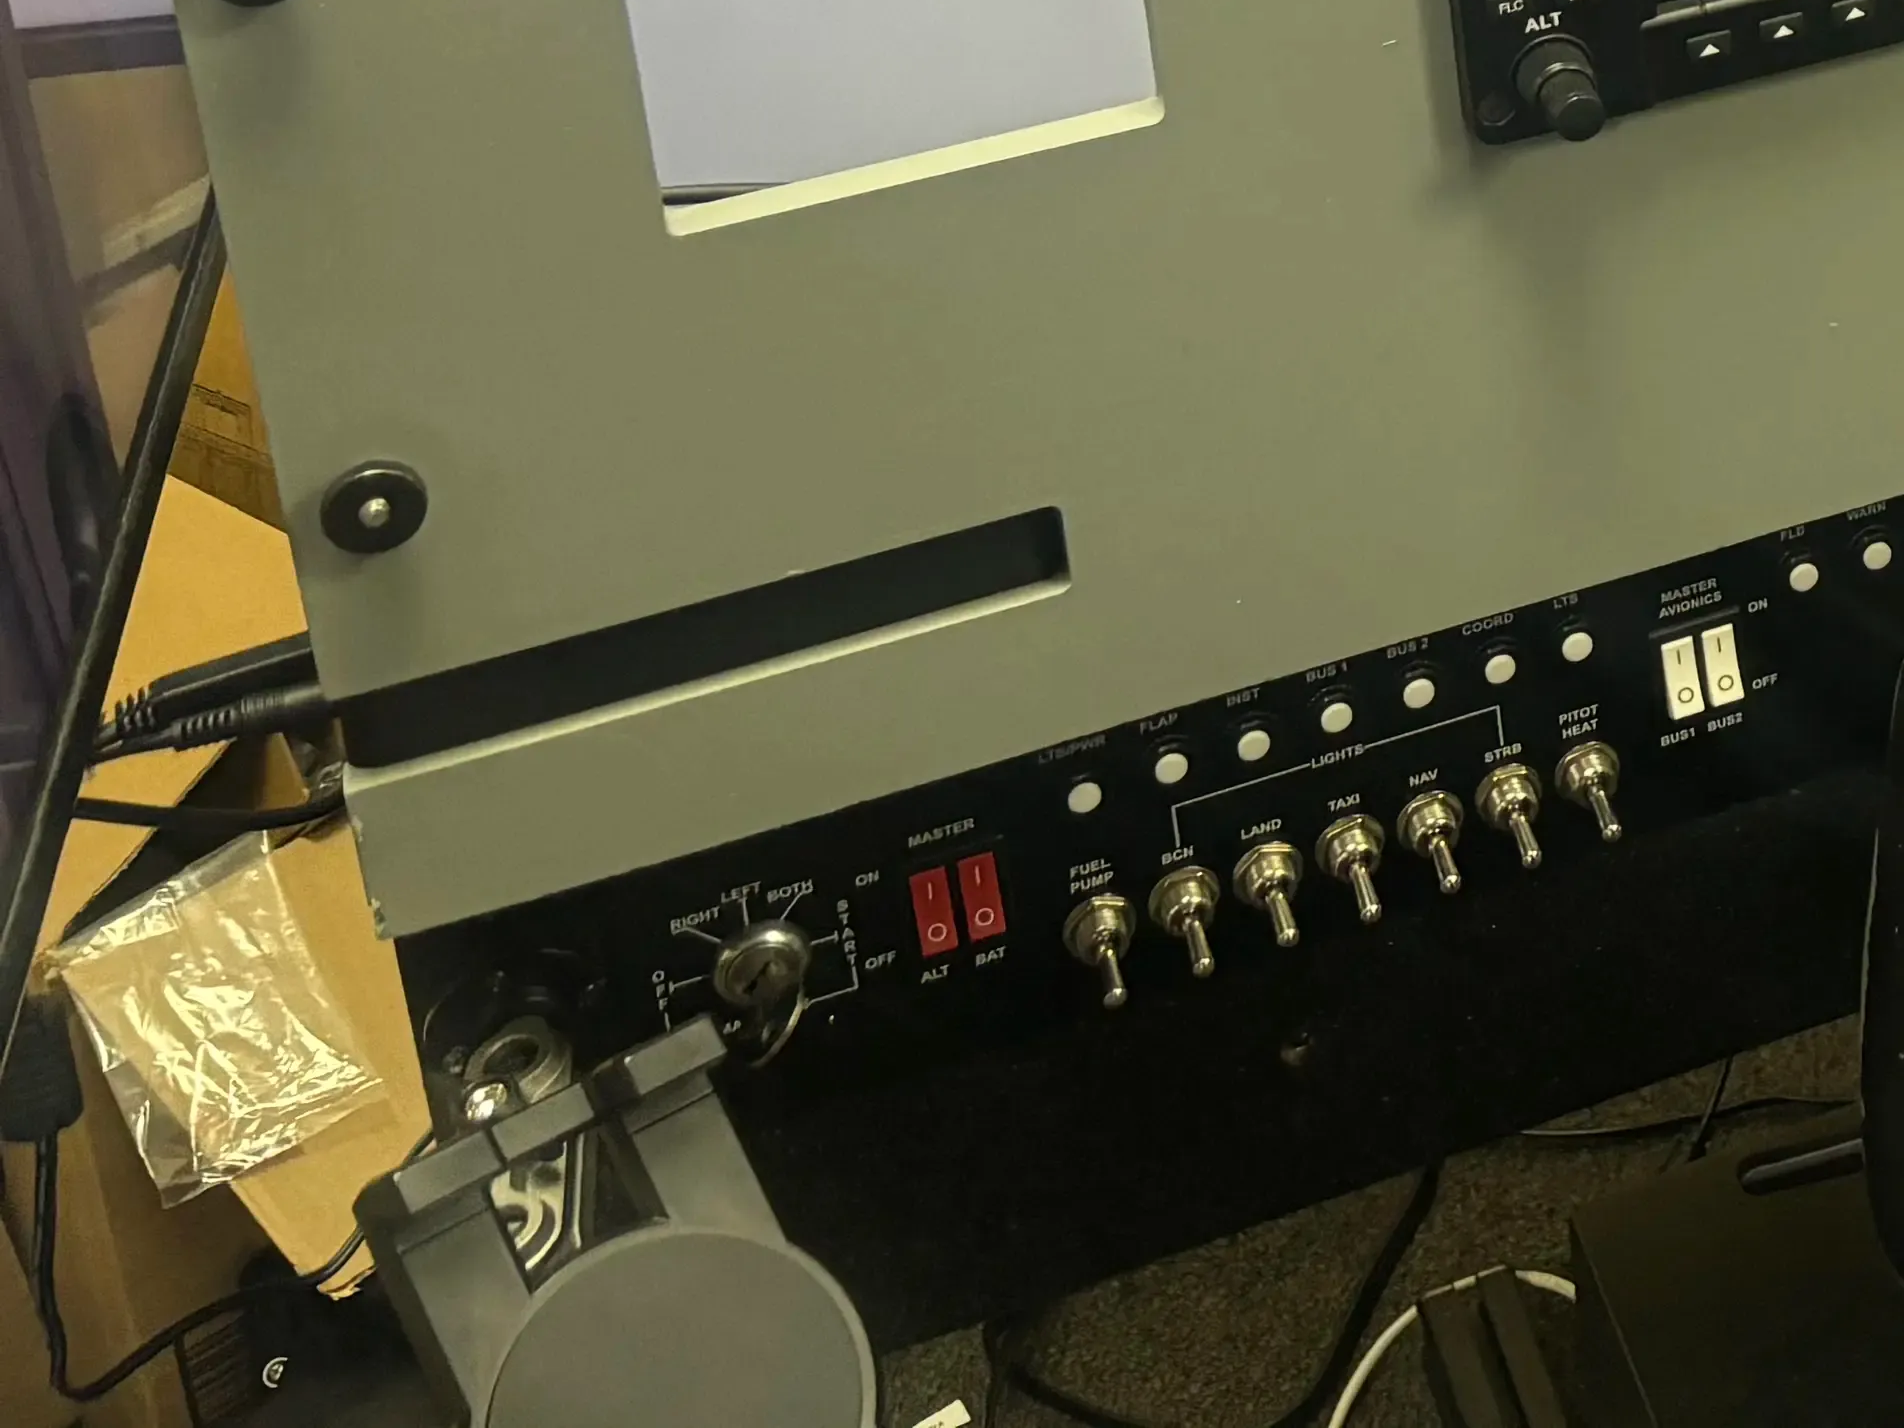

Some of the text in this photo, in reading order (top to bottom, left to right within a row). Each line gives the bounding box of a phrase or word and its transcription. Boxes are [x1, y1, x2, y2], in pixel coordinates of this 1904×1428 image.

[1661, 577, 1717, 604] MASTER
[1659, 591, 1722, 619] AVIONICS
[1752, 673, 1778, 690] OFF
[1558, 704, 1598, 727] PITOT
[1562, 718, 1598, 739] HEAT
[1660, 727, 1696, 748] BUS1
[1311, 743, 1365, 769] LIGHTS
[1484, 743, 1522, 763] STRB
[1409, 768, 1438, 788] NAV
[1328, 793, 1360, 813] TAXI
[908, 818, 974, 848] MASTER
[1241, 818, 1282, 840] LAND
[1162, 845, 1194, 865] BCN
[855, 870, 879, 888] ON
[1070, 858, 1110, 879] FUEL
[721, 881, 761, 903] LEFT
[1070, 871, 1114, 895] PUMP
[865, 950, 897, 971] OFF
[975, 947, 1006, 966] BAT
[921, 965, 949, 984] ALT
